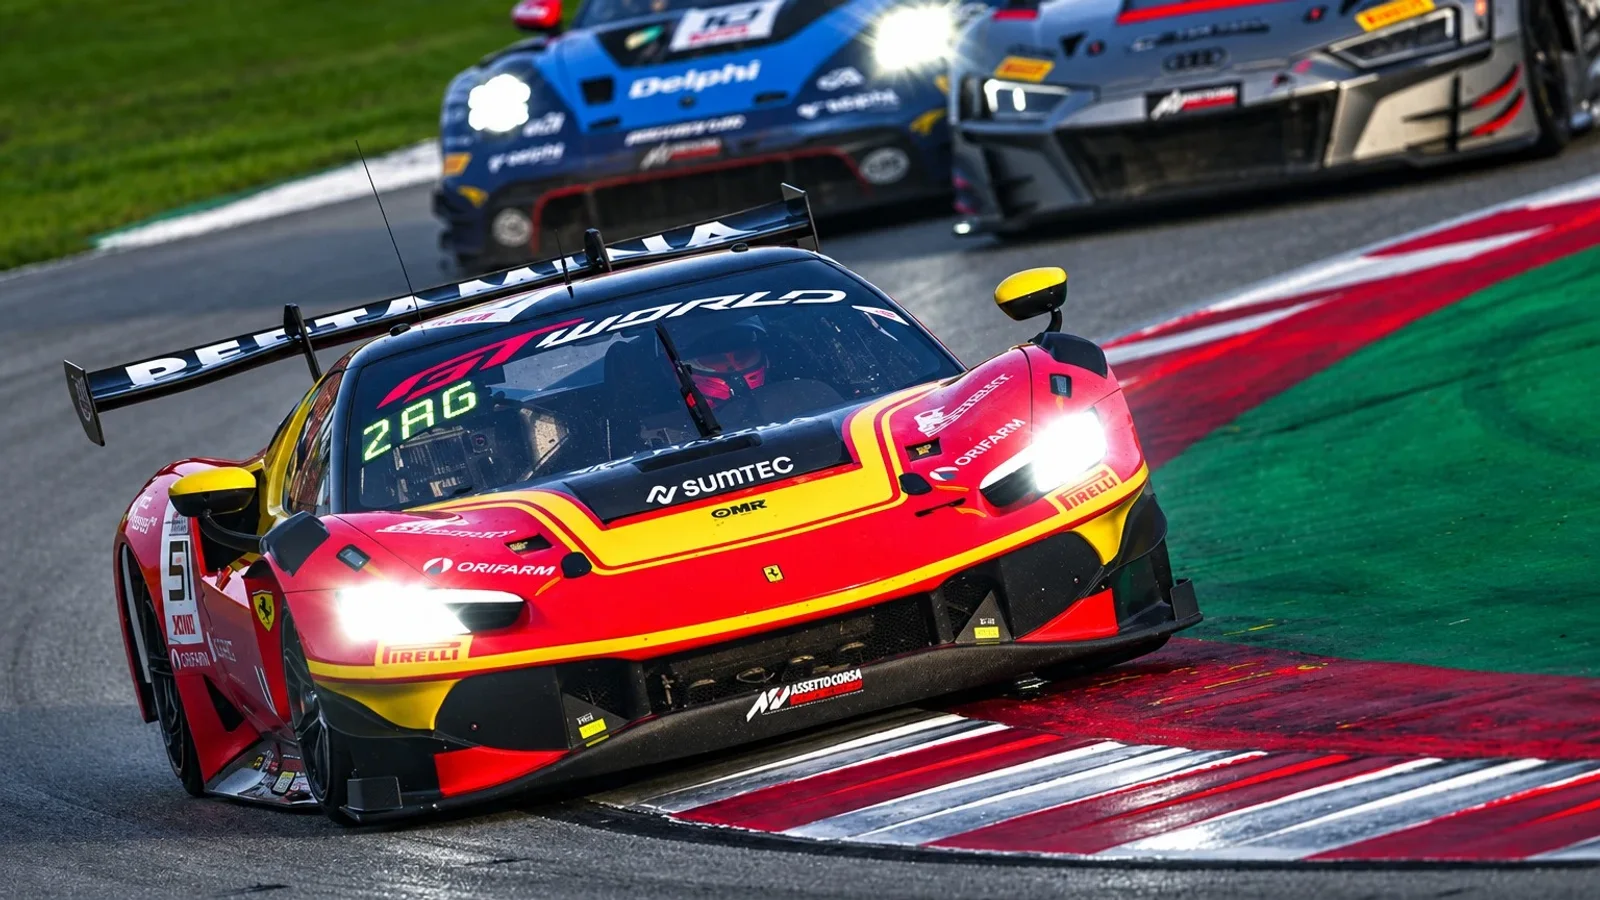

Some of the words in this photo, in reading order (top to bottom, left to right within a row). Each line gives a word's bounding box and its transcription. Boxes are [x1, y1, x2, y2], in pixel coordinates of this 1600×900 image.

[628, 59, 761, 99] Delphi
[376, 317, 584, 410] GT
[535, 289, 847, 349] WORLD
[954, 418, 1026, 466] ORIFARM
[711, 499, 768, 518] OMR
[1054, 468, 1118, 513] PIRELLI
[168, 540, 193, 602] 51
[457, 561, 556, 576] ORIFARM
[382, 641, 462, 665] PIRELLI
[790, 675, 831, 696] ASSETTO
[830, 668, 863, 687] CORSA
